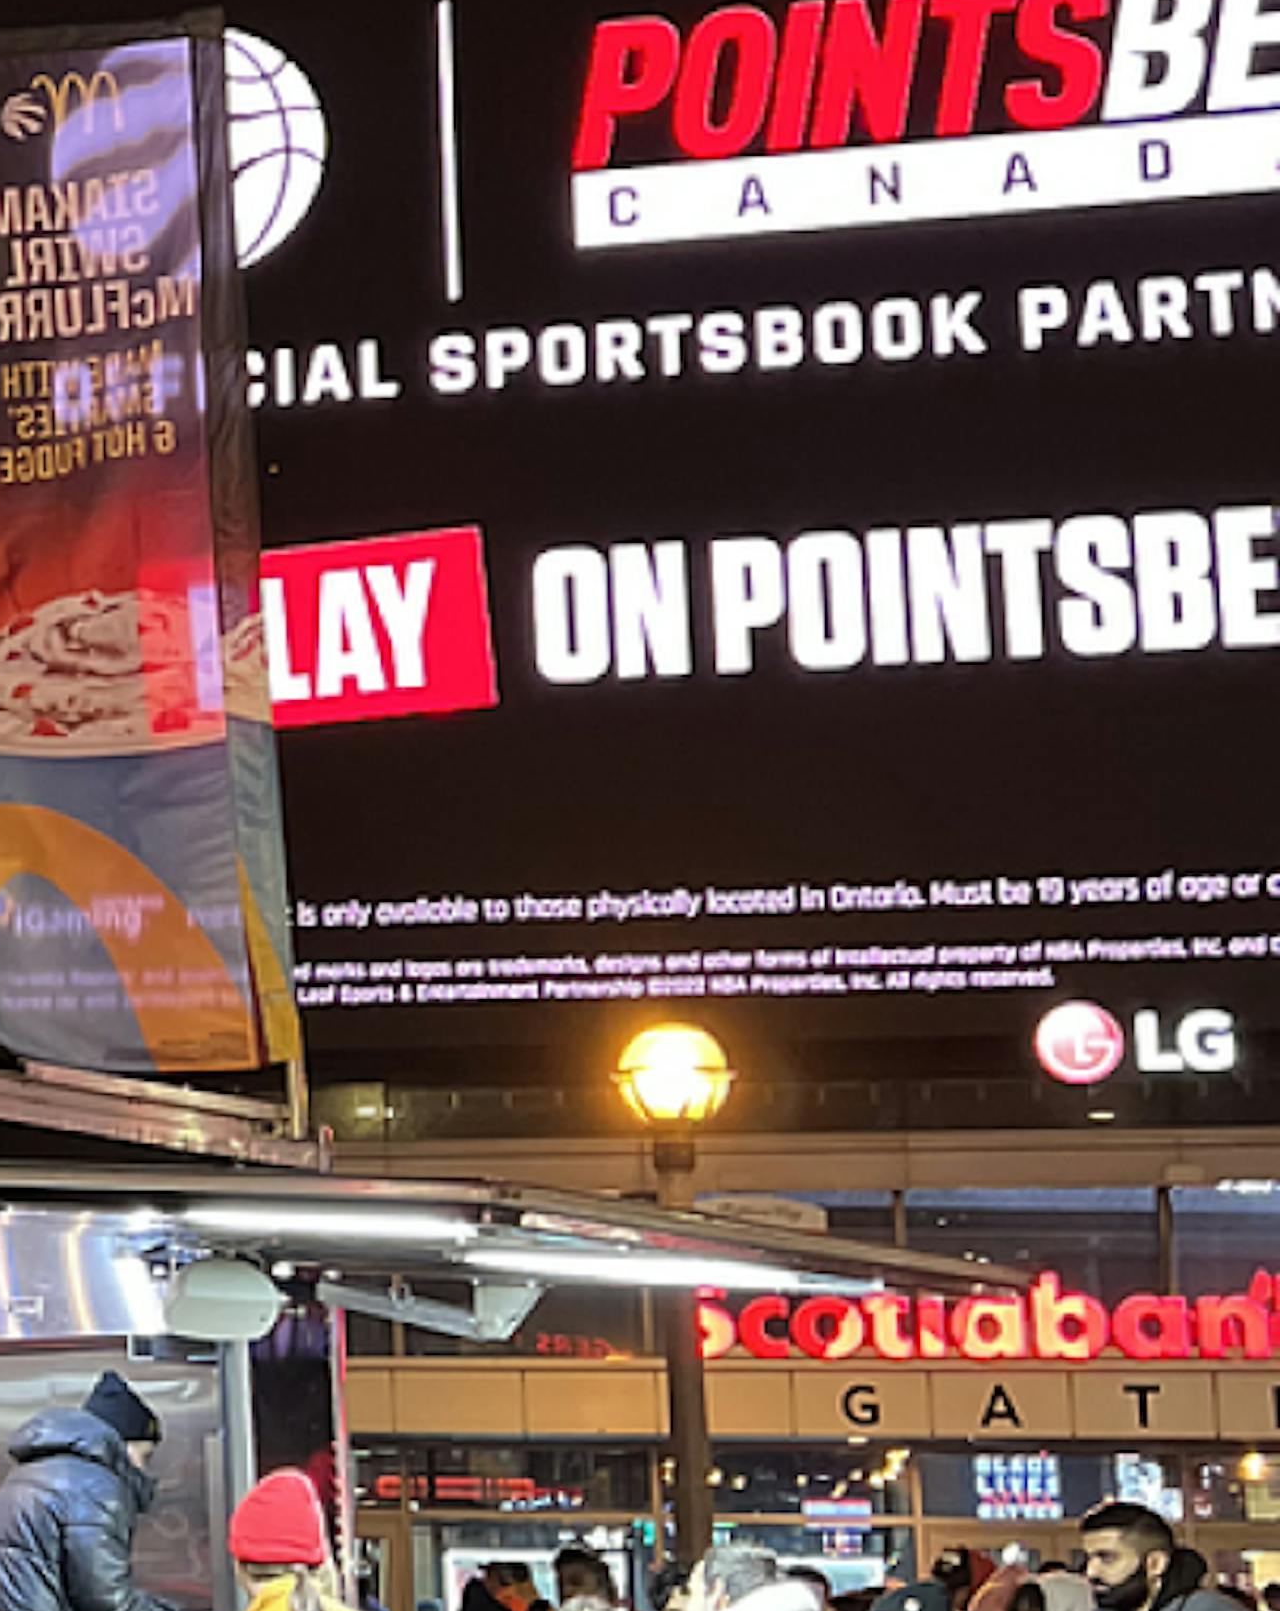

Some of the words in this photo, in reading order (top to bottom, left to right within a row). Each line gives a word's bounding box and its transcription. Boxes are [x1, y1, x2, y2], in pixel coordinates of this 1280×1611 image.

[608, 136, 1280, 226] CANAD
[430, 291, 985, 393] SPORTSBOOK
[261, 558, 436, 701] LAY
[532, 540, 692, 685] ON
[321, 898, 372, 929] only
[375, 896, 479, 926] available
[482, 898, 510, 922] to
[513, 892, 583, 921] those
[586, 888, 703, 923] physically
[705, 885, 794, 914] located
[800, 884, 826, 910] in
[928, 878, 994, 905] Must
[996, 876, 1032, 905] be
[1036, 876, 1065, 904] 19
[1068, 874, 1140, 907] years
[1146, 867, 1175, 902] of
[1178, 873, 1231, 902] age
[1133, 1008, 1236, 1072] LG
[695, 1268, 1280, 1361] Scotiaban
[842, 1384, 1280, 1429] GAT
